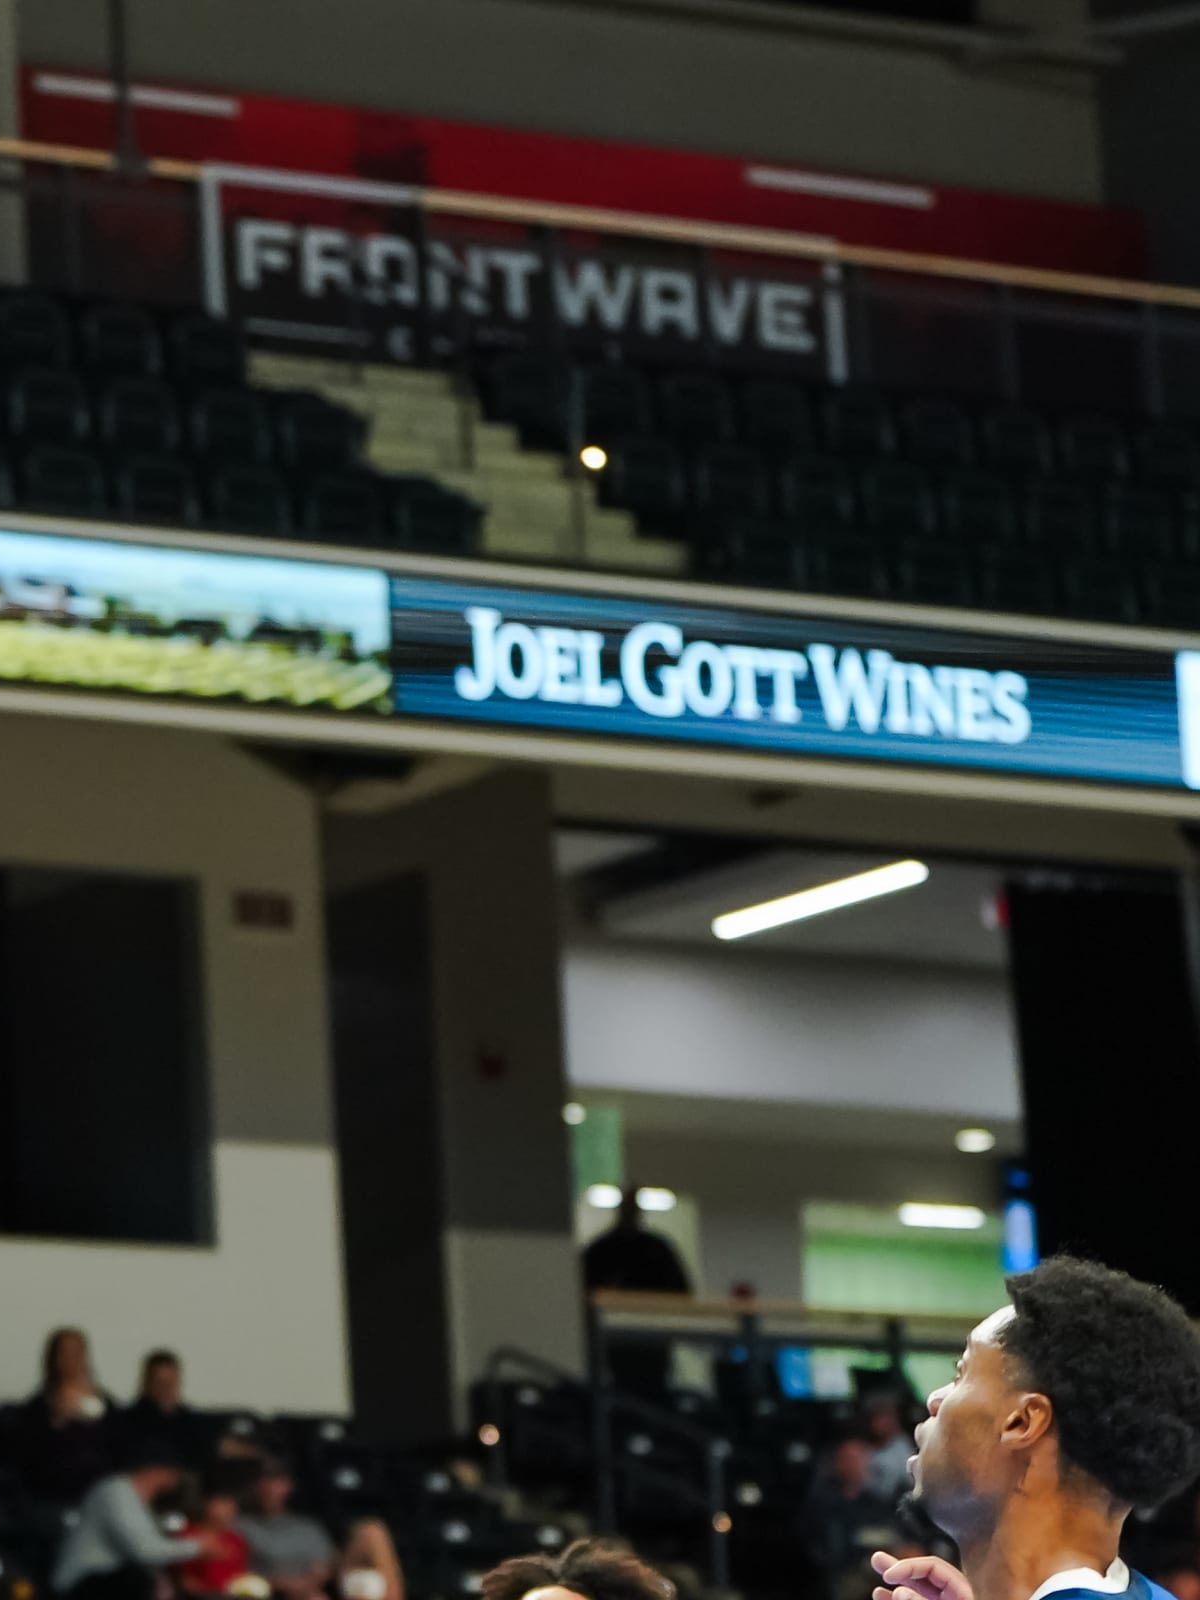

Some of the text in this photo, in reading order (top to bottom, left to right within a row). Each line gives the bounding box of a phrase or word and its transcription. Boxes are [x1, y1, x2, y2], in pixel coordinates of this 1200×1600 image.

[454, 606, 1032, 745] JOEL GOTT WINES
